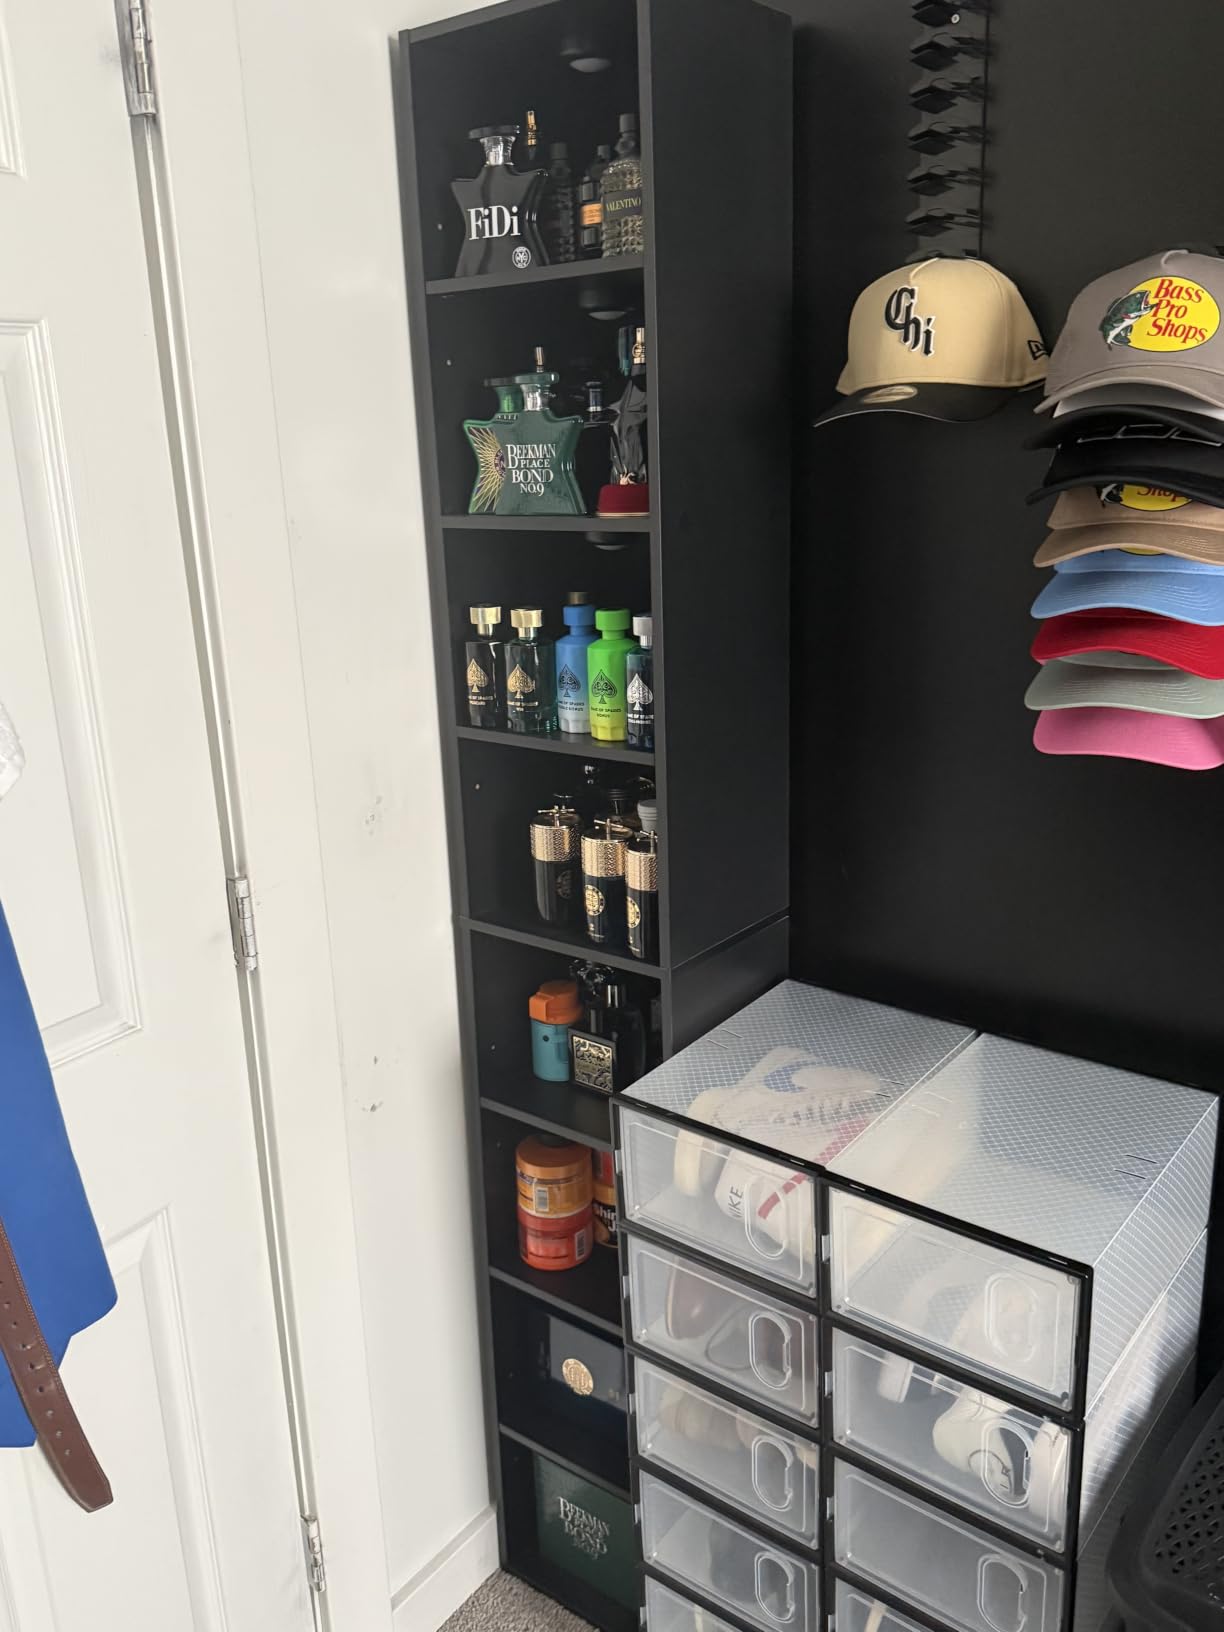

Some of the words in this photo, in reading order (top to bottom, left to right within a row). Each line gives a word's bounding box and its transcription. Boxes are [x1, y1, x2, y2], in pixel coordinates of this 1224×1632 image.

[467, 204, 521, 241] FiDi
[1153, 278, 1204, 304] Bass
[884, 286, 936, 357] Chi
[1151, 299, 1188, 319] Pro
[1147, 317, 1208, 344] Shops
[505, 443, 556, 469] BEEKMAN
[520, 458, 550, 468] PLACE
[511, 468, 554, 483] BOND
